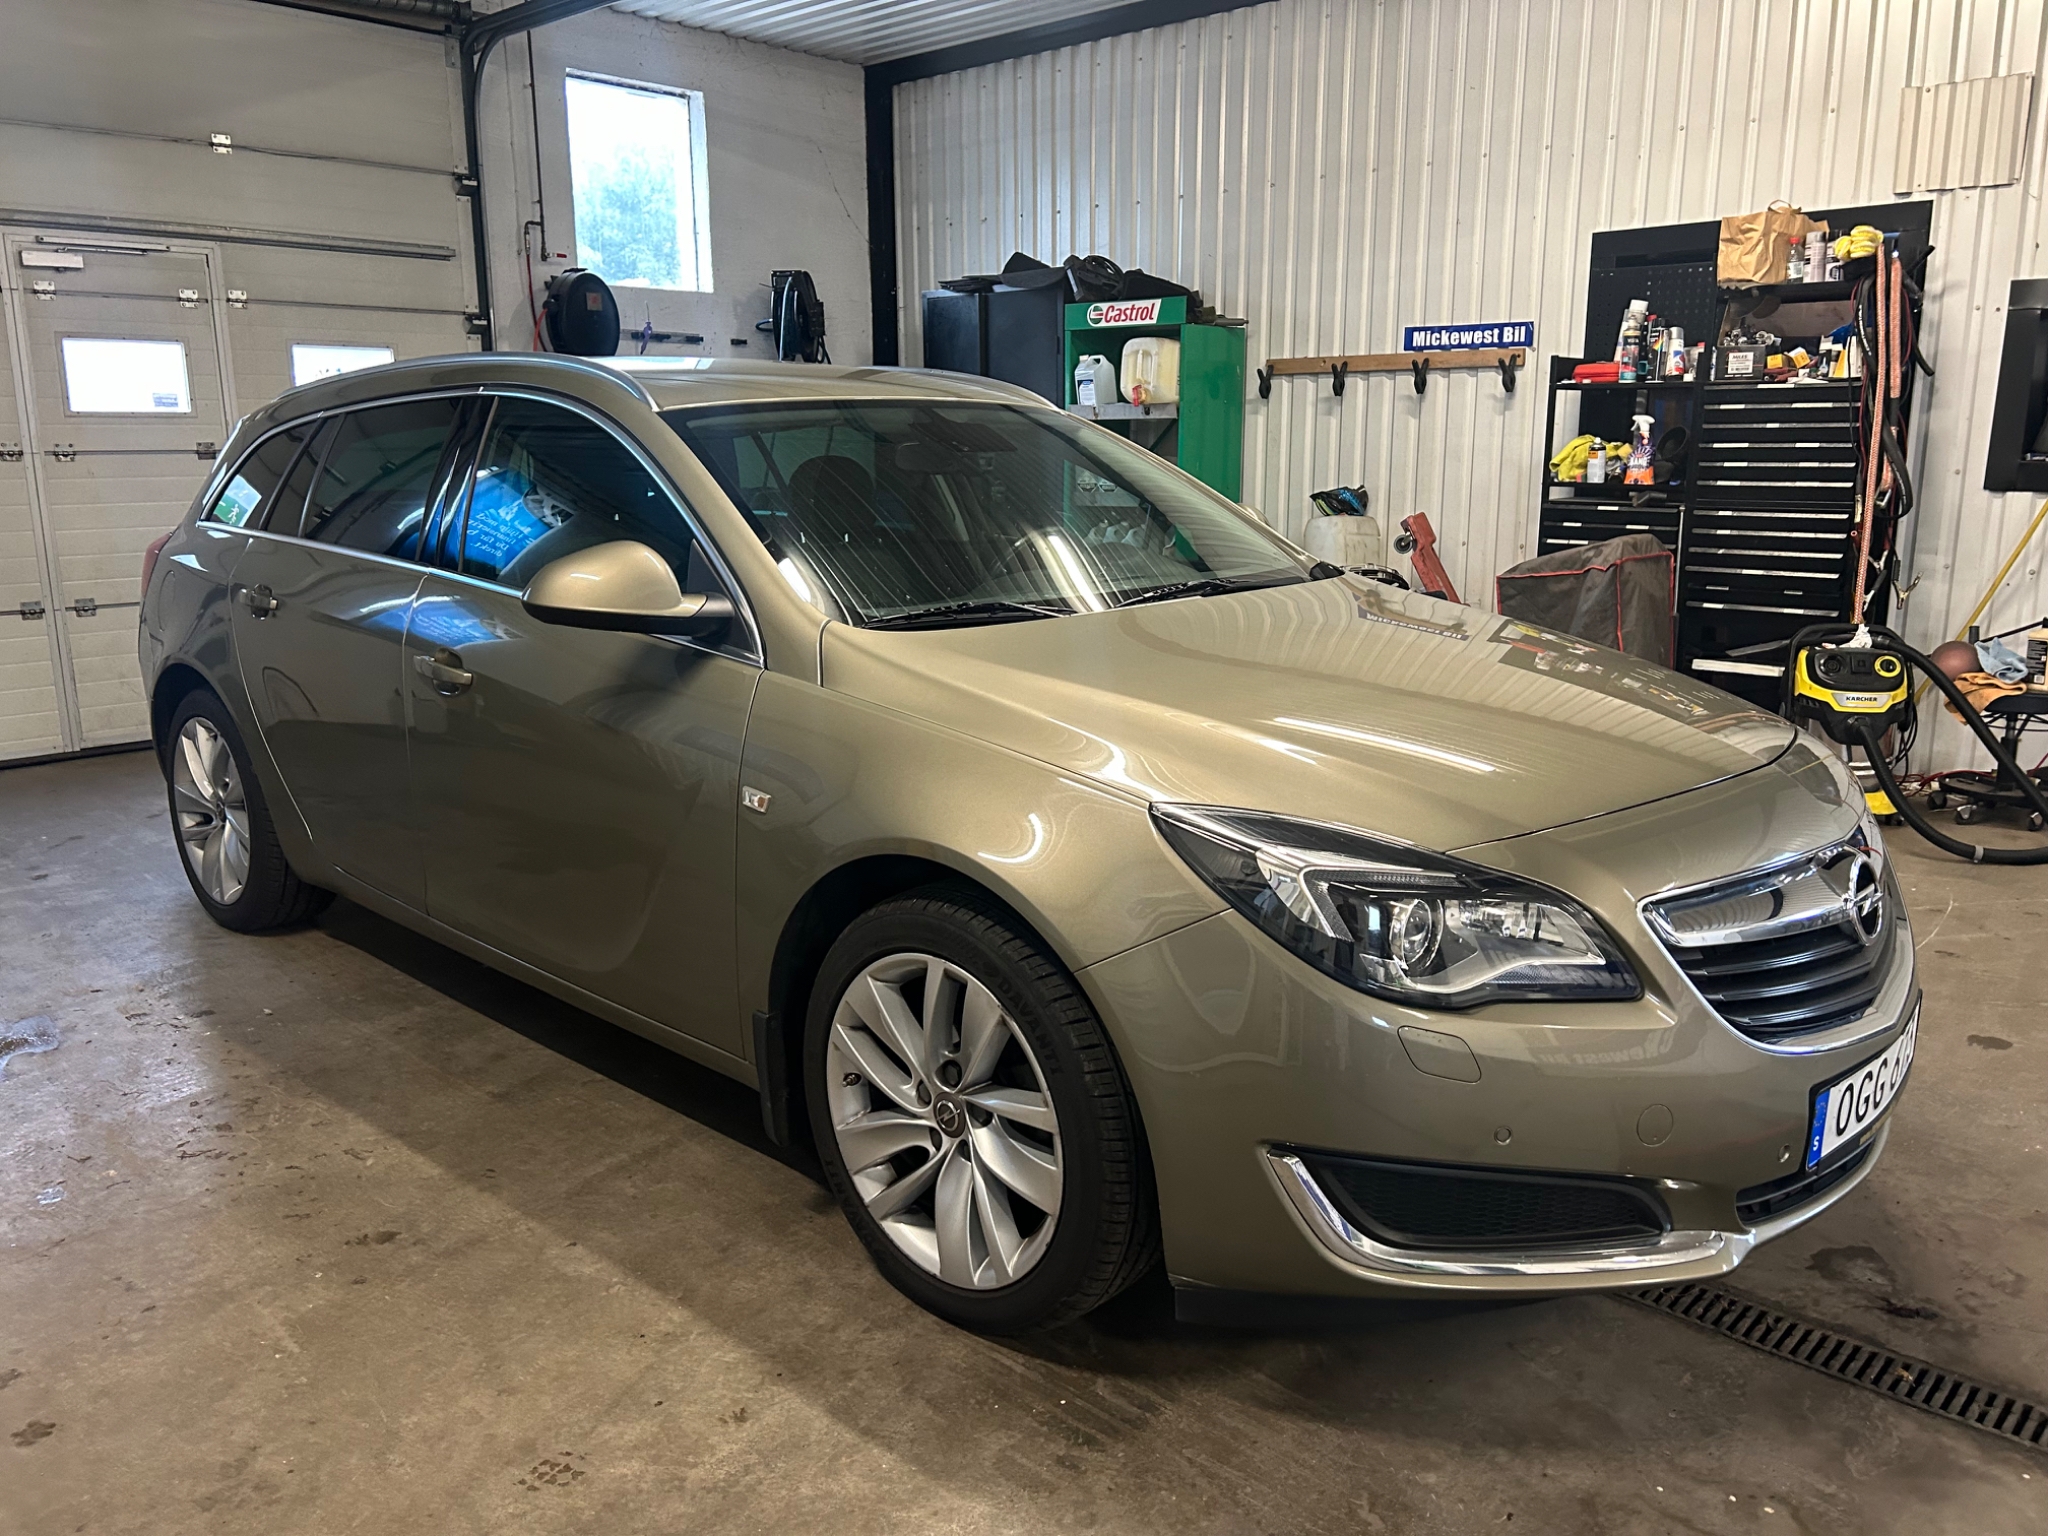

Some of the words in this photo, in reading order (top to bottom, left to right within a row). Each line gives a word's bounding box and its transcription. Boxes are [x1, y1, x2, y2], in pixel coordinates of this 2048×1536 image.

[1104, 302, 1155, 323] Castrol
[1412, 328, 1499, 347] Mickewest
[1502, 326, 1526, 342] Bil
[1836, 1057, 1888, 1137] OGG
[1812, 1135, 1820, 1152] S
